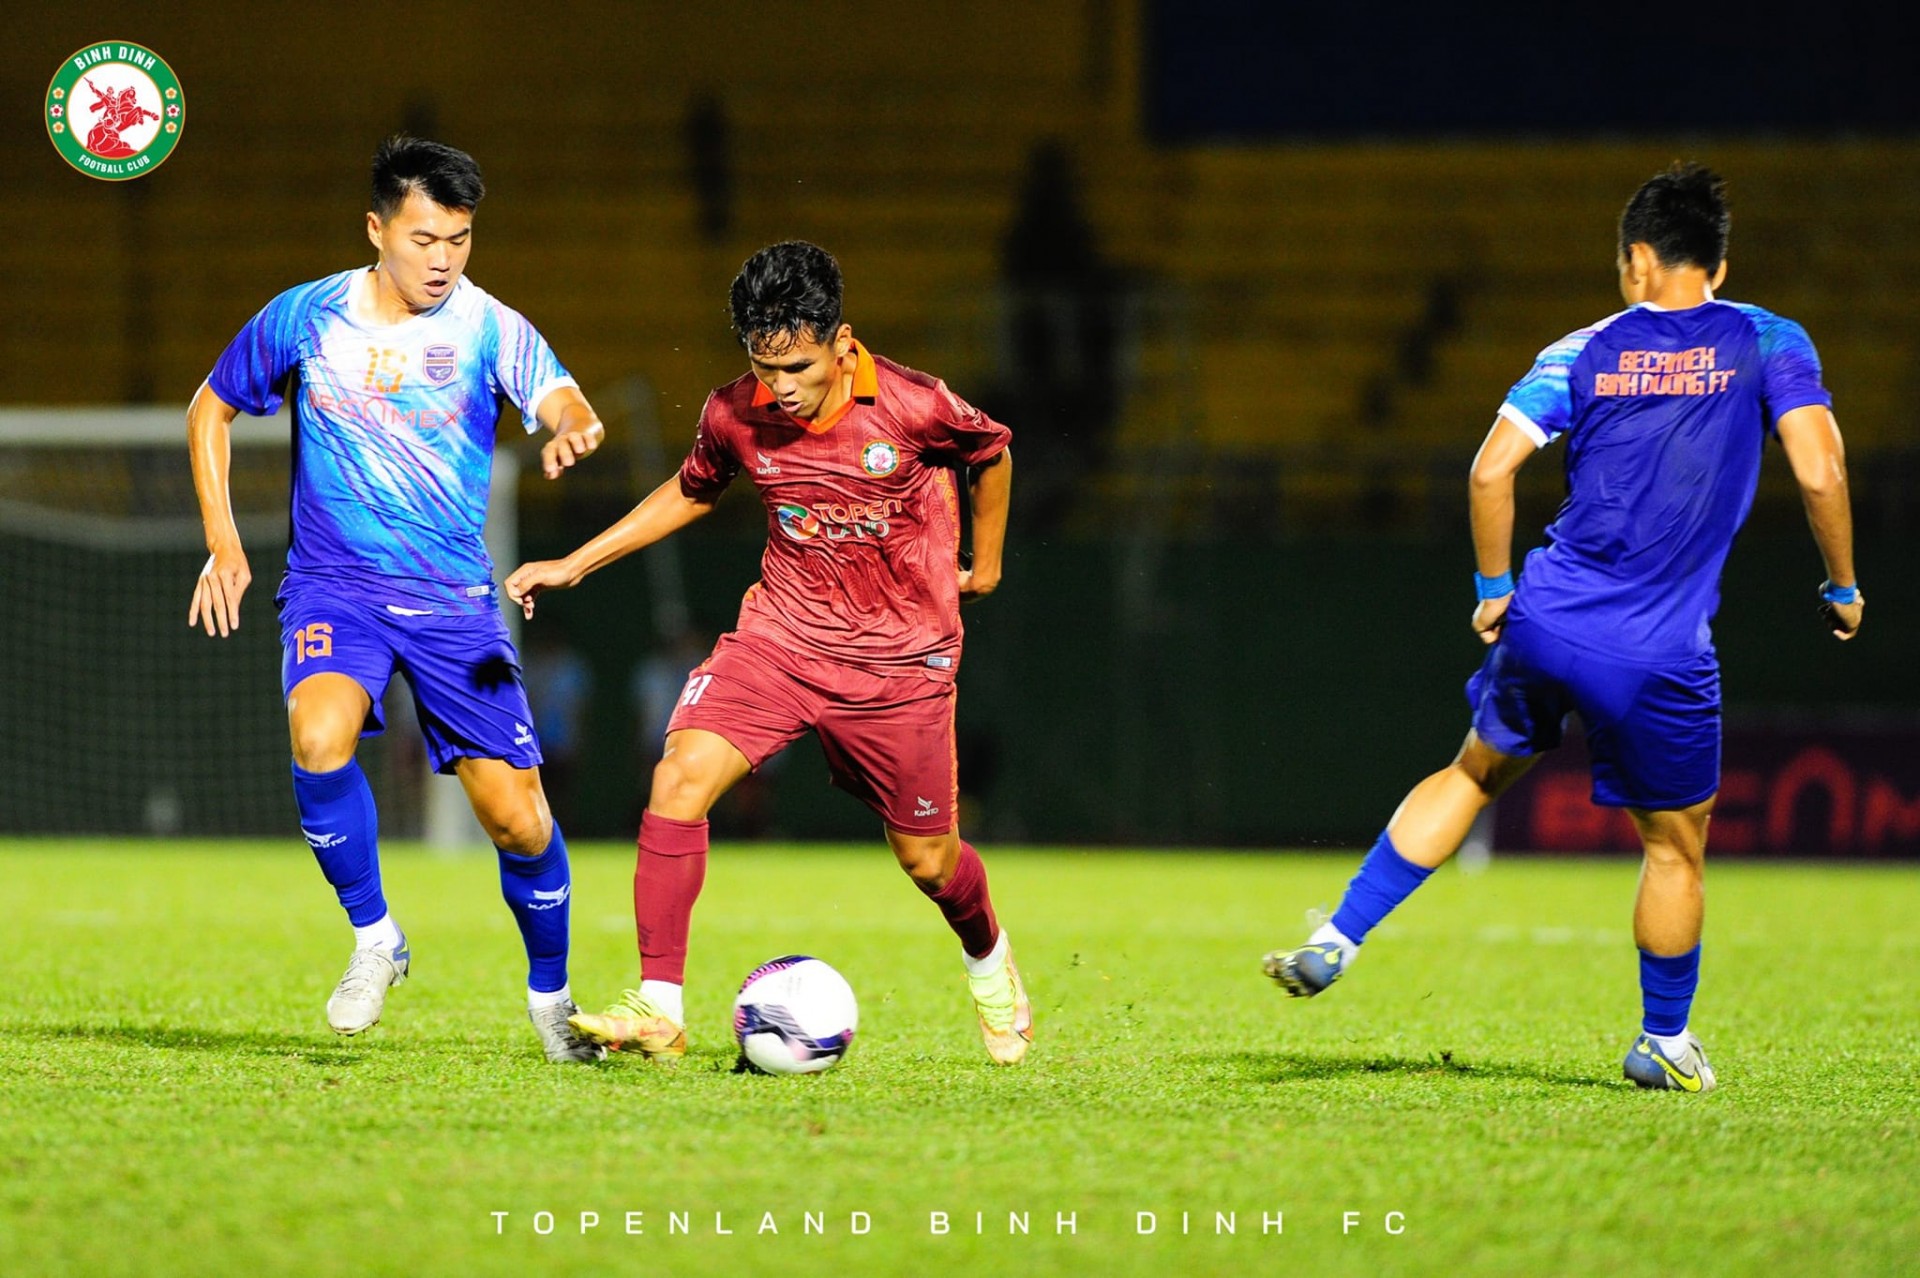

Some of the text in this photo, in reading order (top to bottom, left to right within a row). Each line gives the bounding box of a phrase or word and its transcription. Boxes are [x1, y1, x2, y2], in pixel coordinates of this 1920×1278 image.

[364, 346, 407, 393] 15
[812, 498, 902, 523] TOPEN
[294, 622, 333, 666] 15
